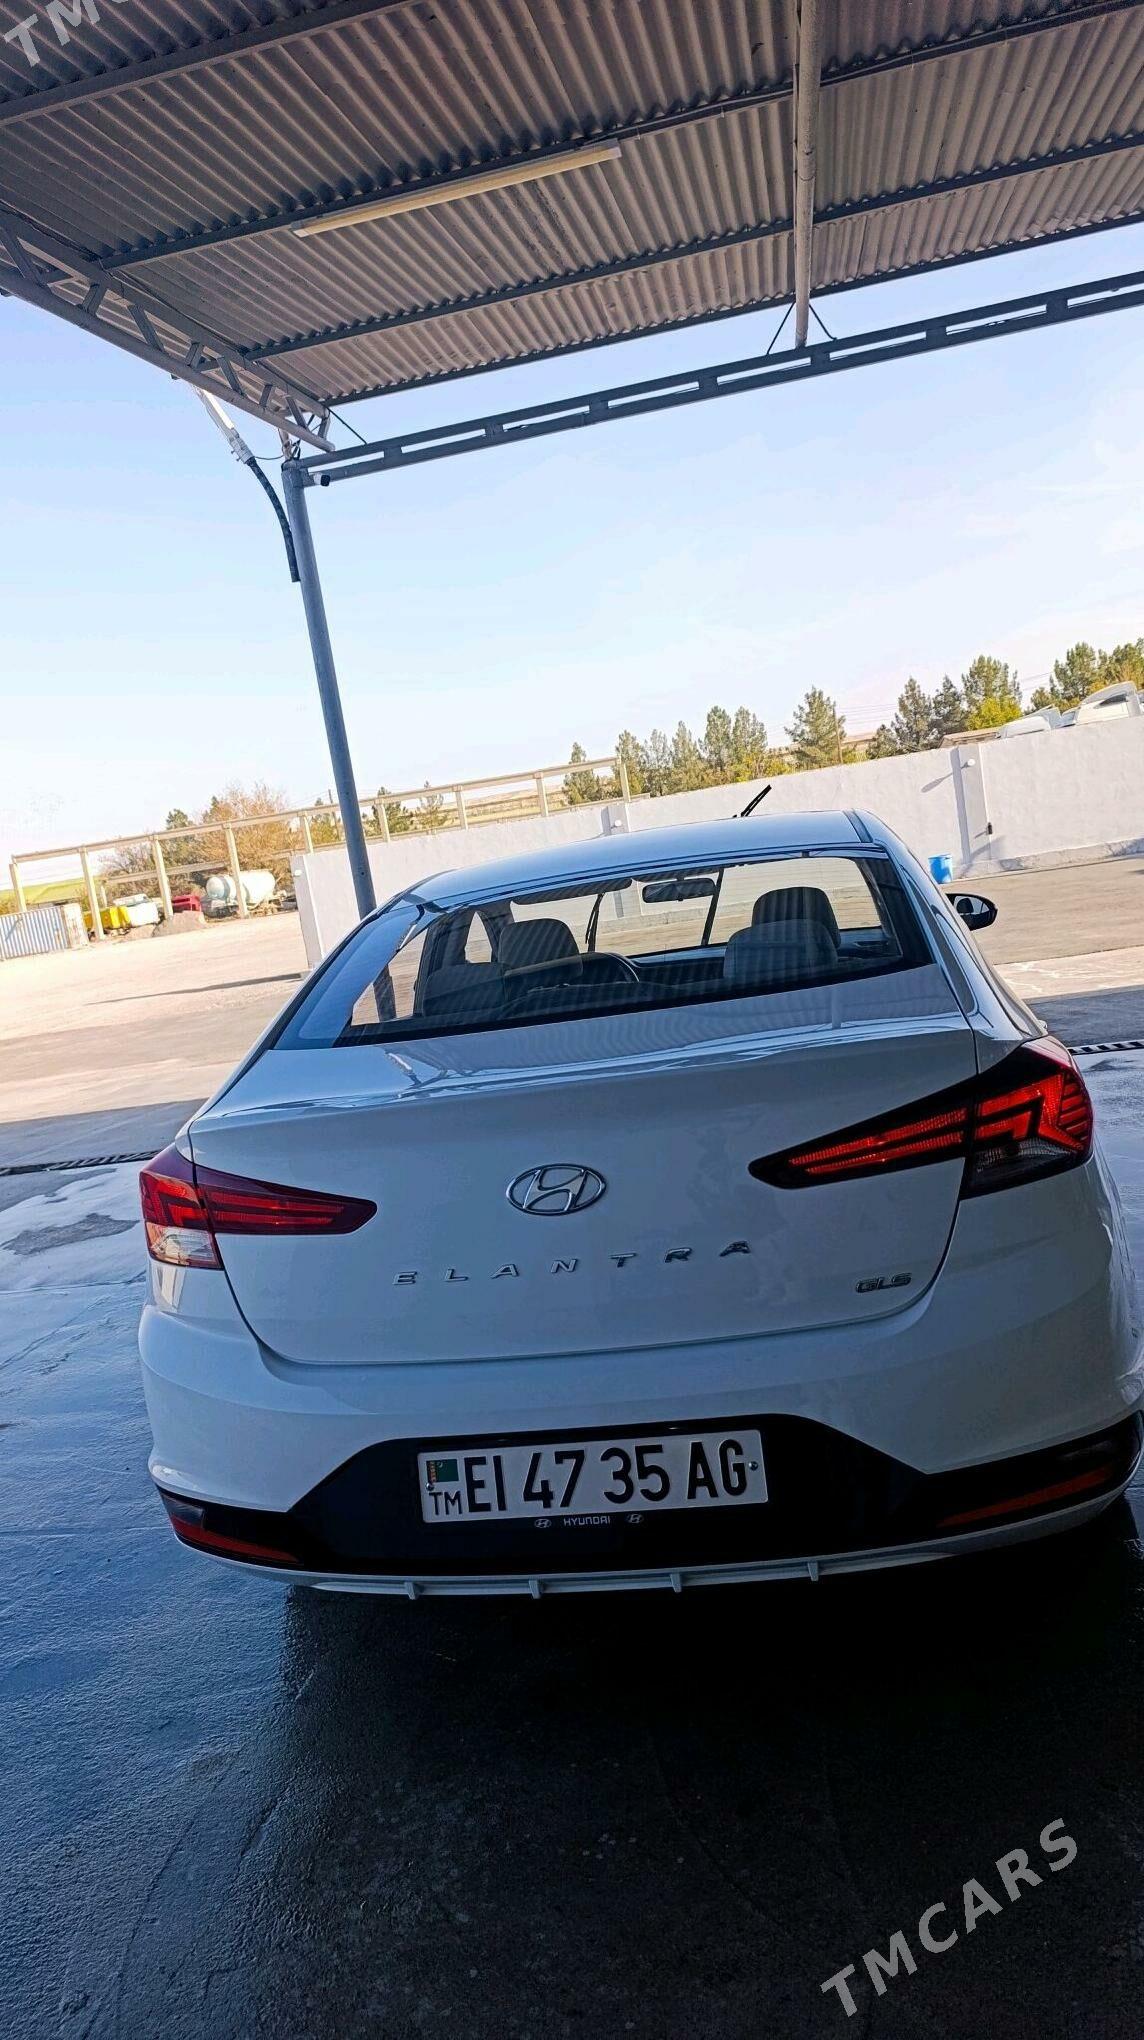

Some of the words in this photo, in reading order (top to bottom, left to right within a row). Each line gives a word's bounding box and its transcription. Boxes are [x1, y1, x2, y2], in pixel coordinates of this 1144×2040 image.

[393, 1240, 751, 1286] ELANTRA
[856, 1272, 911, 1294] GLS
[464, 1455, 507, 1513] EI
[522, 1450, 585, 1508] 47
[600, 1444, 671, 1504] 35
[687, 1438, 748, 1499] AG
[428, 1490, 463, 1515] TM
[563, 1515, 611, 1526] HYUNDAI
